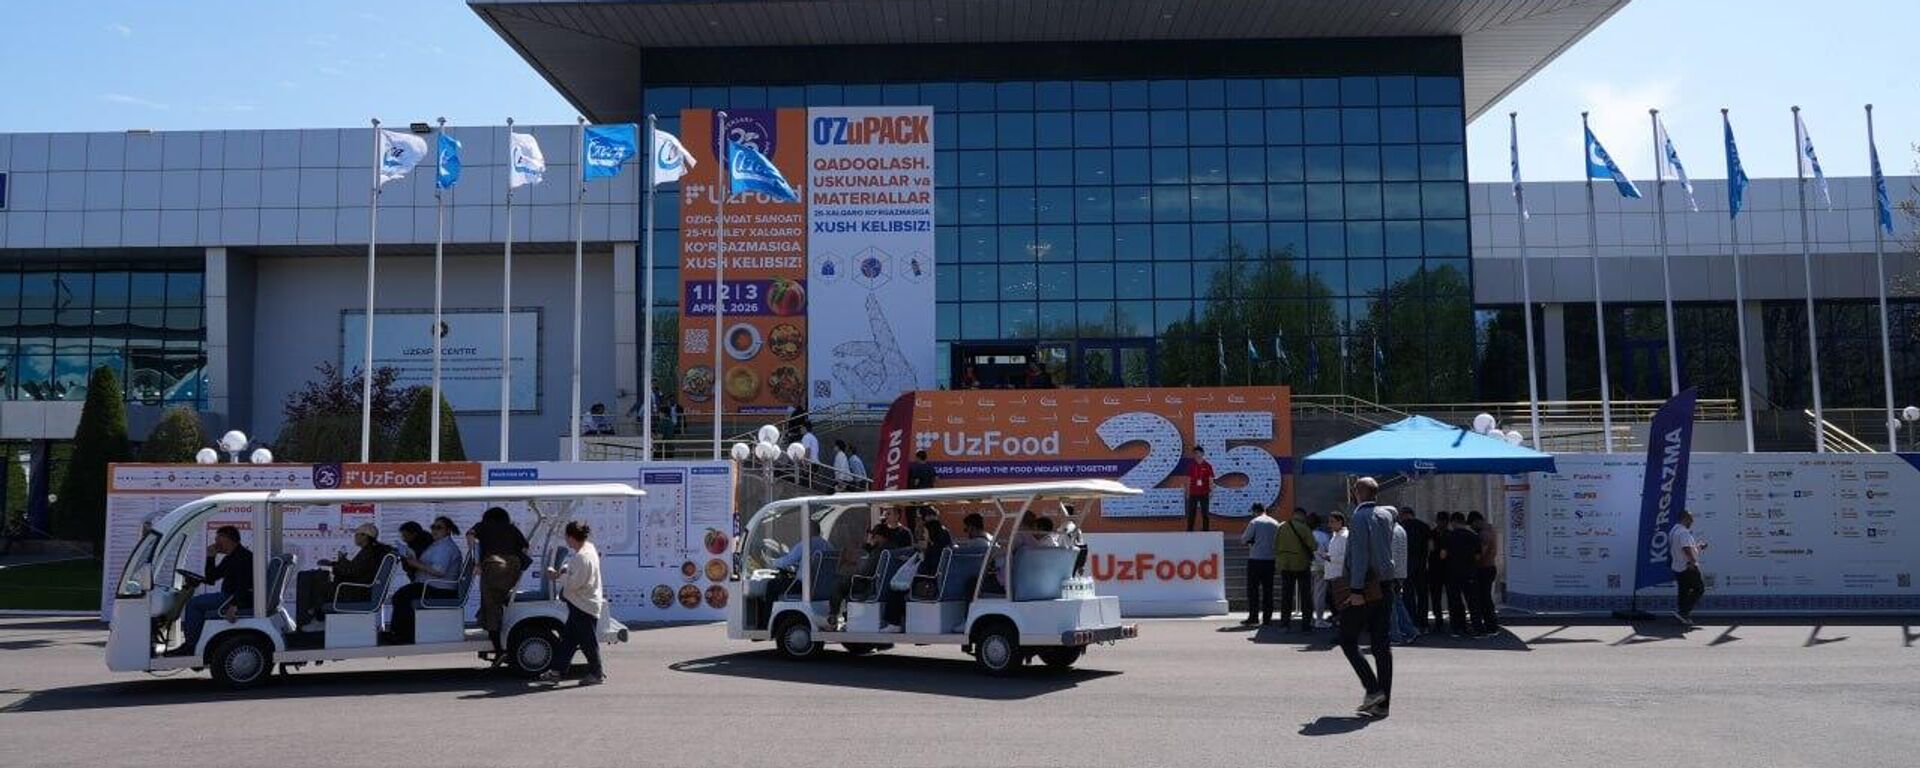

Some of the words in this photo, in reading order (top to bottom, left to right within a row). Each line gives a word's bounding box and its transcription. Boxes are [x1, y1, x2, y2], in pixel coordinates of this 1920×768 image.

[814, 175, 909, 187] USKUNALAR
[914, 177, 930, 186] va
[814, 192, 930, 205] MATERIALLAR
[755, 214, 802, 223] SANOATI
[749, 228, 801, 237] XALQARO
[814, 221, 857, 233] XUSH
[861, 220, 931, 232] KELIBSIZ!
[732, 256, 802, 268] KELIBSIZ!
[692, 284, 702, 300] 1
[719, 284, 730, 300] 2
[745, 284, 758, 300] 3
[730, 303, 758, 312] 2026
[943, 430, 1059, 456] UzFood
[955, 466, 991, 474] SHAPING
[1010, 465, 1032, 473] FOOD
[1034, 465, 1073, 473] INDUSTRY
[1076, 464, 1118, 472] TOGETHER
[1095, 411, 1282, 517] 25
[320, 470, 336, 486] 25
[361, 471, 428, 485] UzFood
[1091, 553, 1218, 581] UzFood
